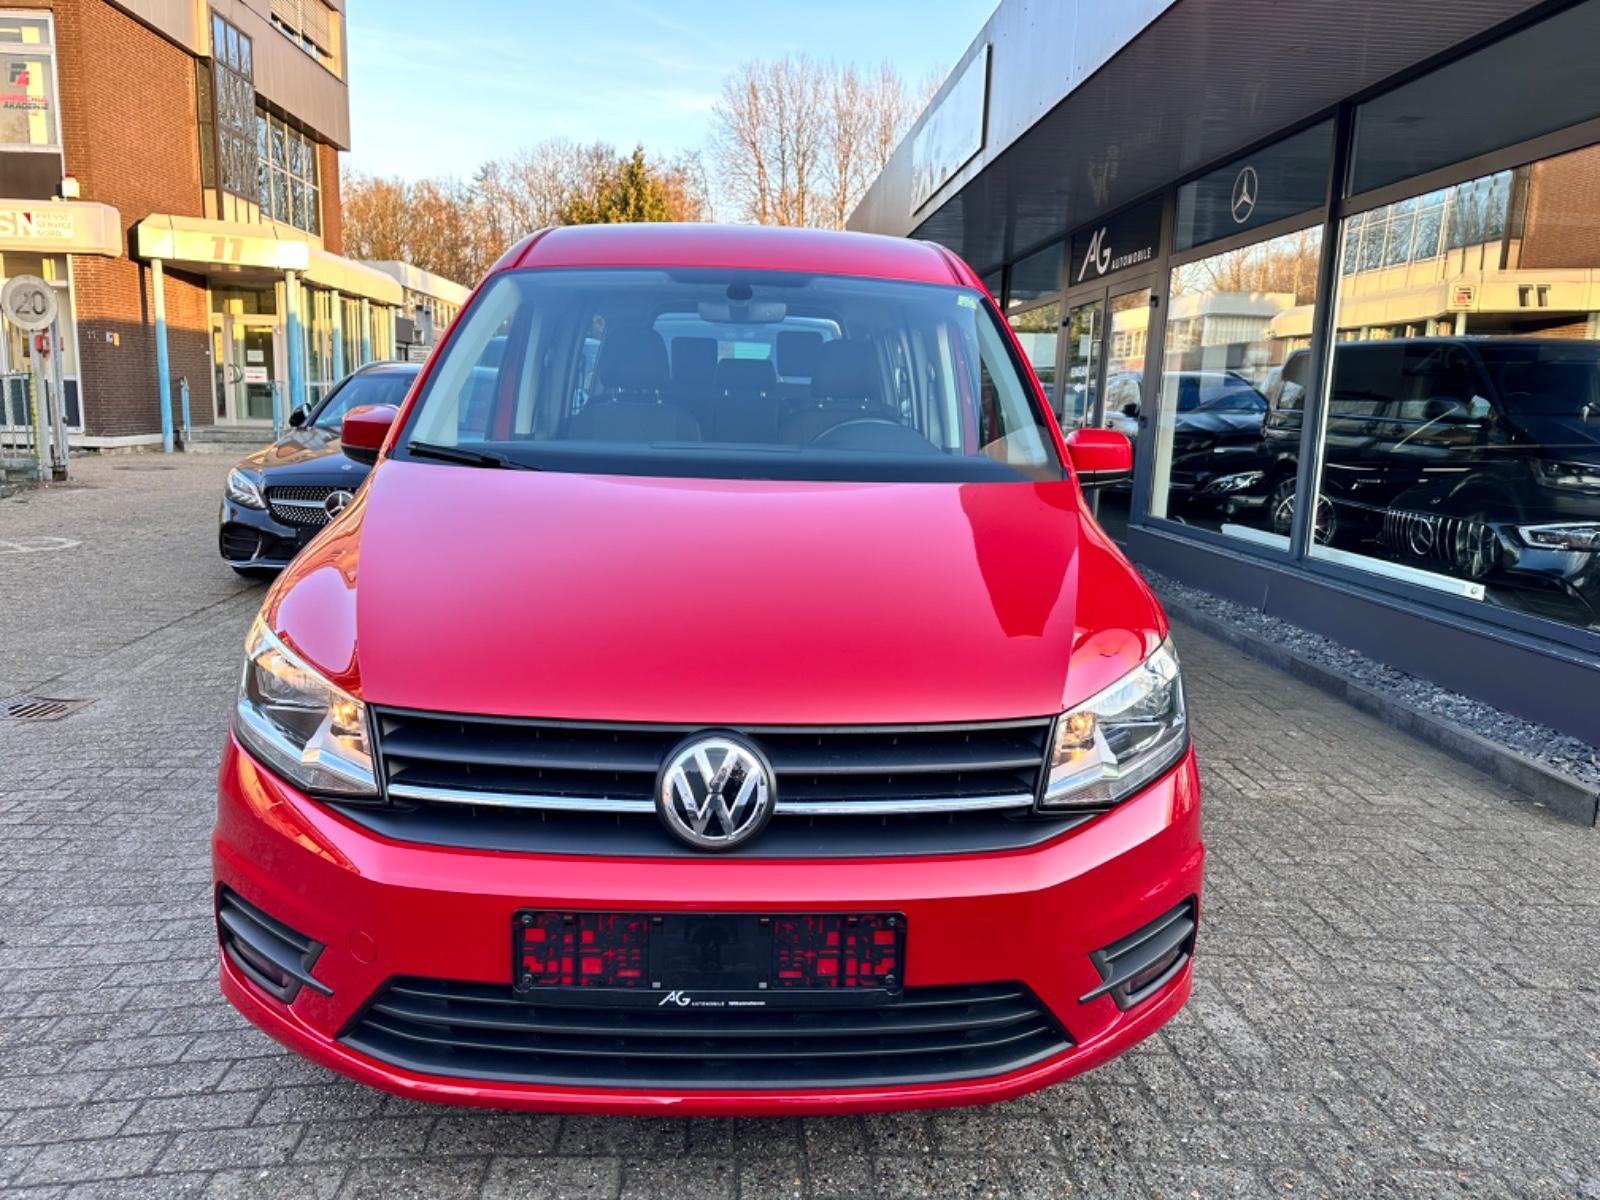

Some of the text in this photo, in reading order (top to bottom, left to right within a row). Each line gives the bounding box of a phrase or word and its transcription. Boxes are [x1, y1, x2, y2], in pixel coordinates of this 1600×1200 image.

[211, 236, 244, 261] 11
[1077, 226, 1152, 282] AG AUTOMOBILE
[16, 290, 46, 315] 20
[658, 990, 691, 1006] AG
